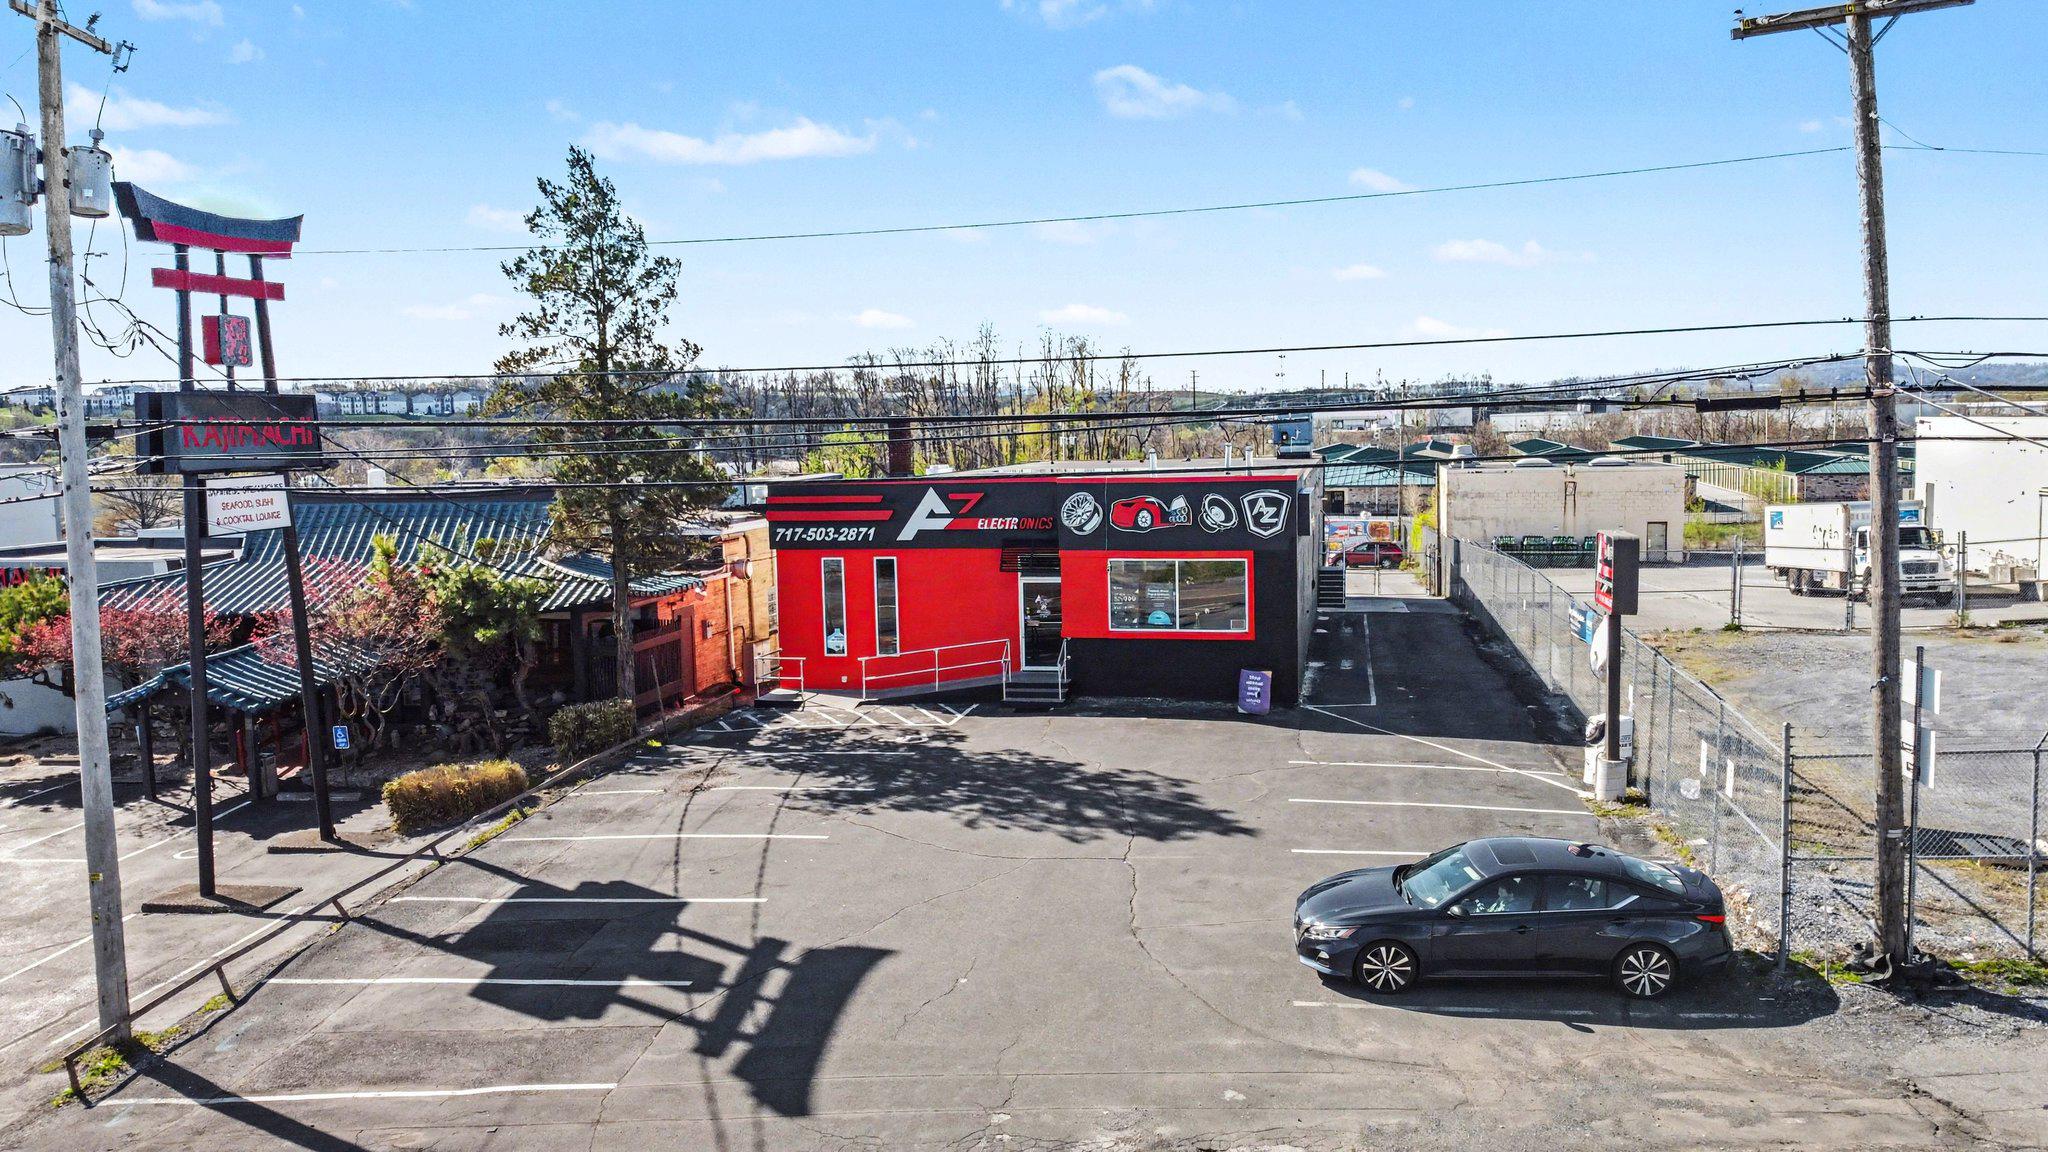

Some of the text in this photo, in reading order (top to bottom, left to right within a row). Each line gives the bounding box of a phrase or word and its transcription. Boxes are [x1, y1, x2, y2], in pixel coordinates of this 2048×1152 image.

[181, 416, 313, 453] KAJIMACHI
[223, 514, 255, 525] COCKTAIL
[256, 511, 282, 521] LOUNGE
[1251, 497, 1279, 523] AZ
[977, 516, 1054, 530] ELECTRONICS
[775, 526, 876, 542] 717-503-2871
